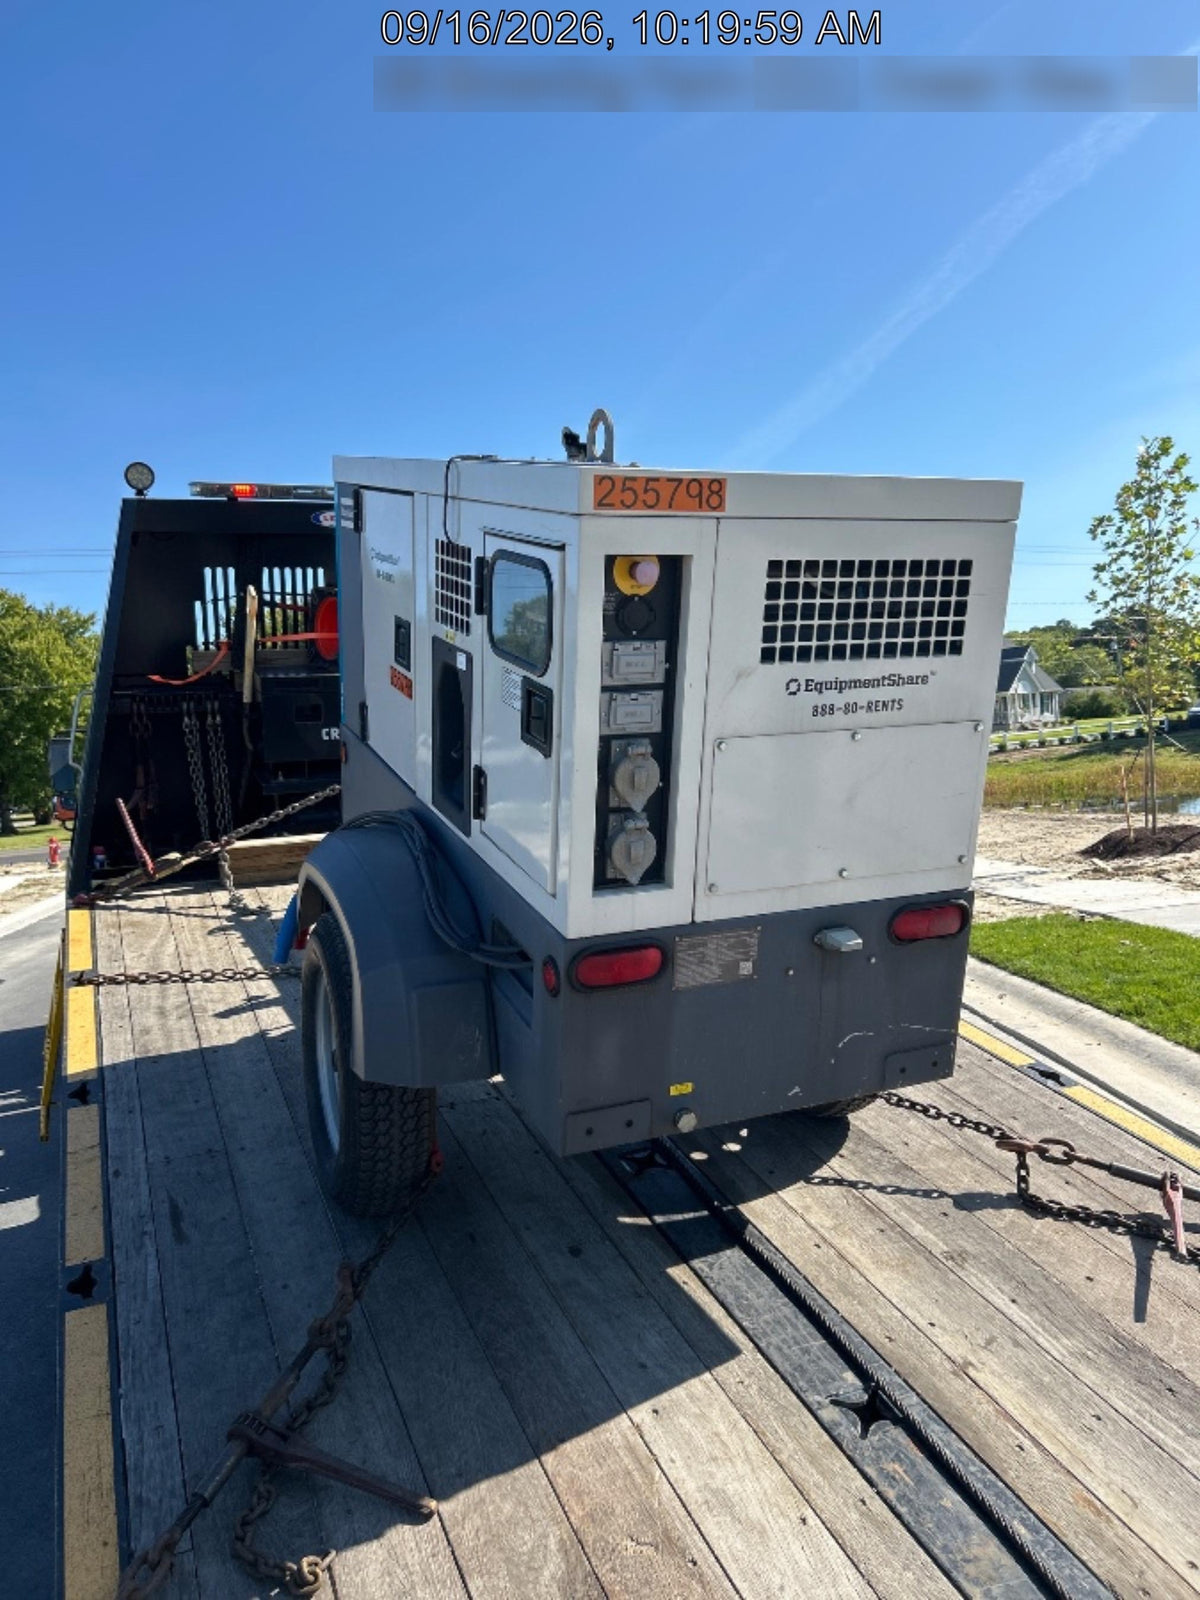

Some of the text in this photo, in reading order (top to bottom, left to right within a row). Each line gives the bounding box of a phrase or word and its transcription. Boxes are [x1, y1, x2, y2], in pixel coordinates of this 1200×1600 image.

[596, 475, 723, 510] 255798
[803, 673, 929, 694] EquipmentShare
[812, 698, 904, 717] 888-80-RENTS
